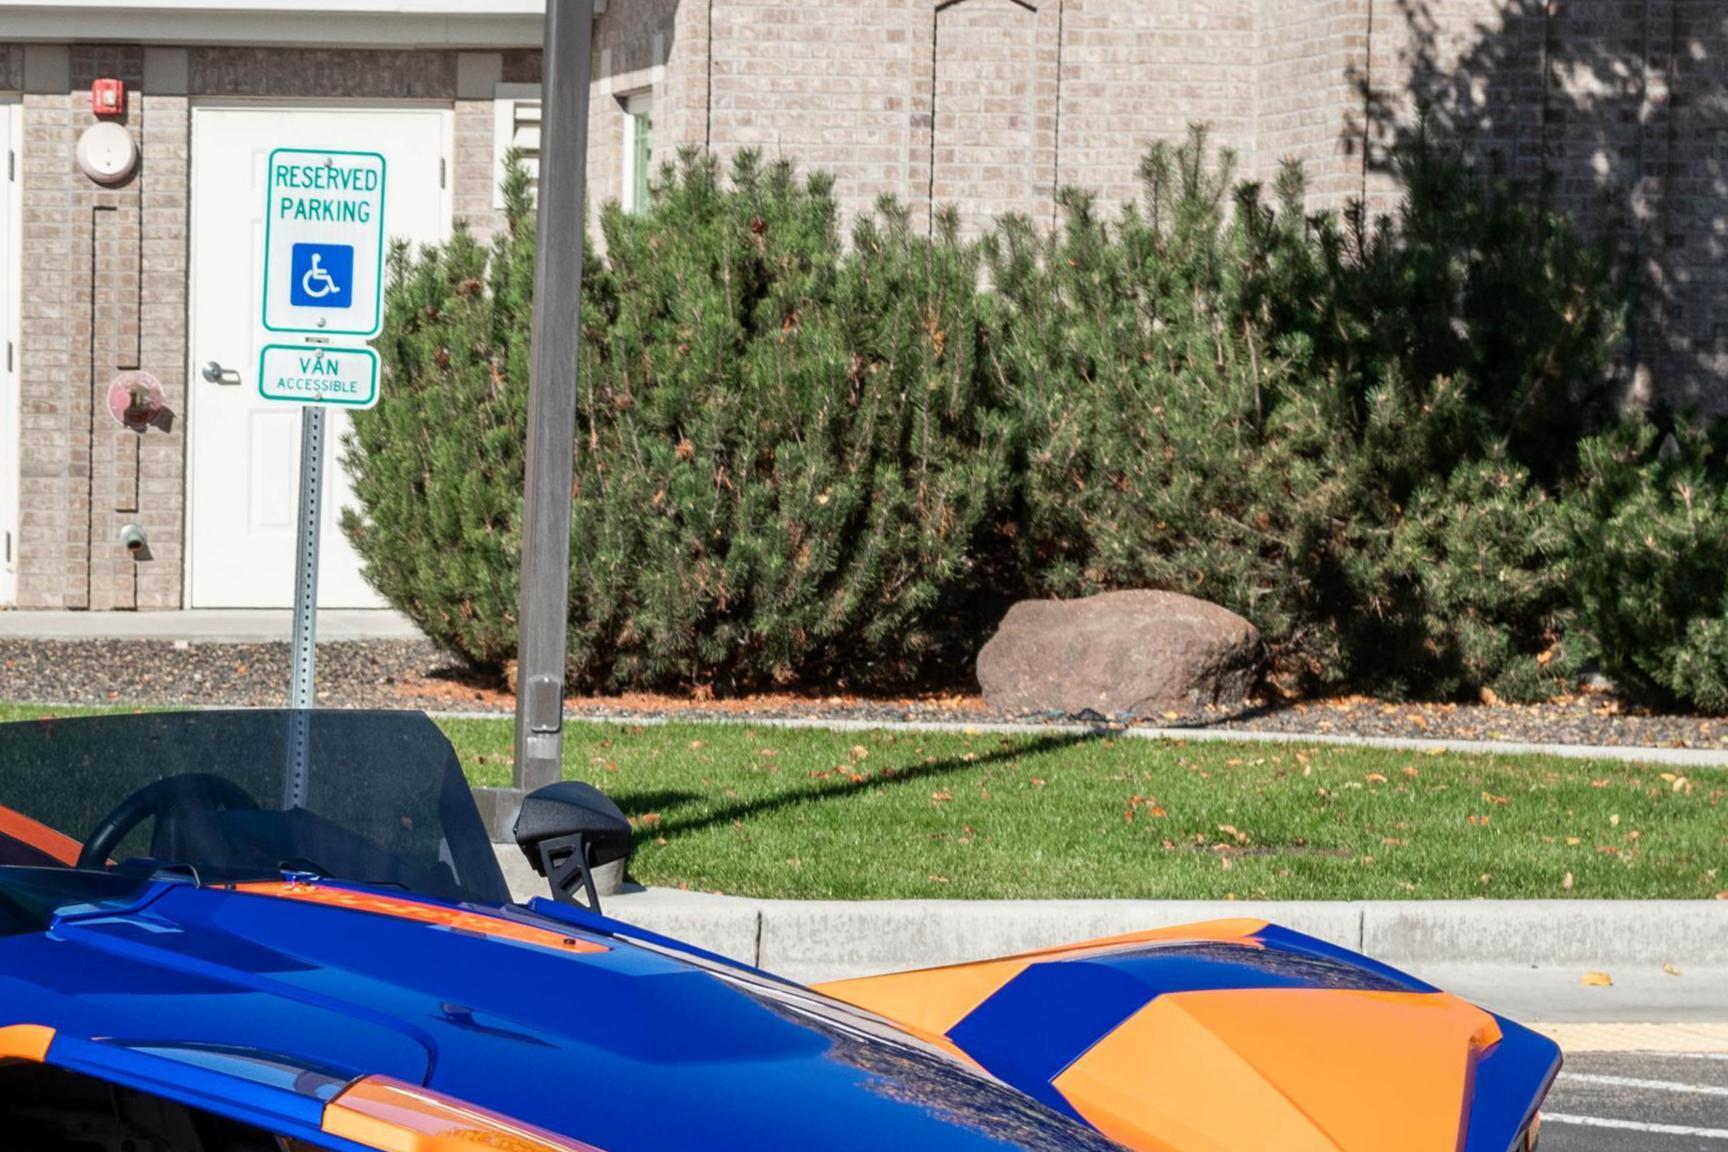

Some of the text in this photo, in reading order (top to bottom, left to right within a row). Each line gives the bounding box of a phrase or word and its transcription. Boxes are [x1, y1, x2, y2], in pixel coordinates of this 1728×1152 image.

[276, 165, 378, 191] RESERVED
[280, 197, 371, 223] PARKING
[299, 356, 339, 376] VAN
[277, 377, 358, 393] ACCESSIBLE
